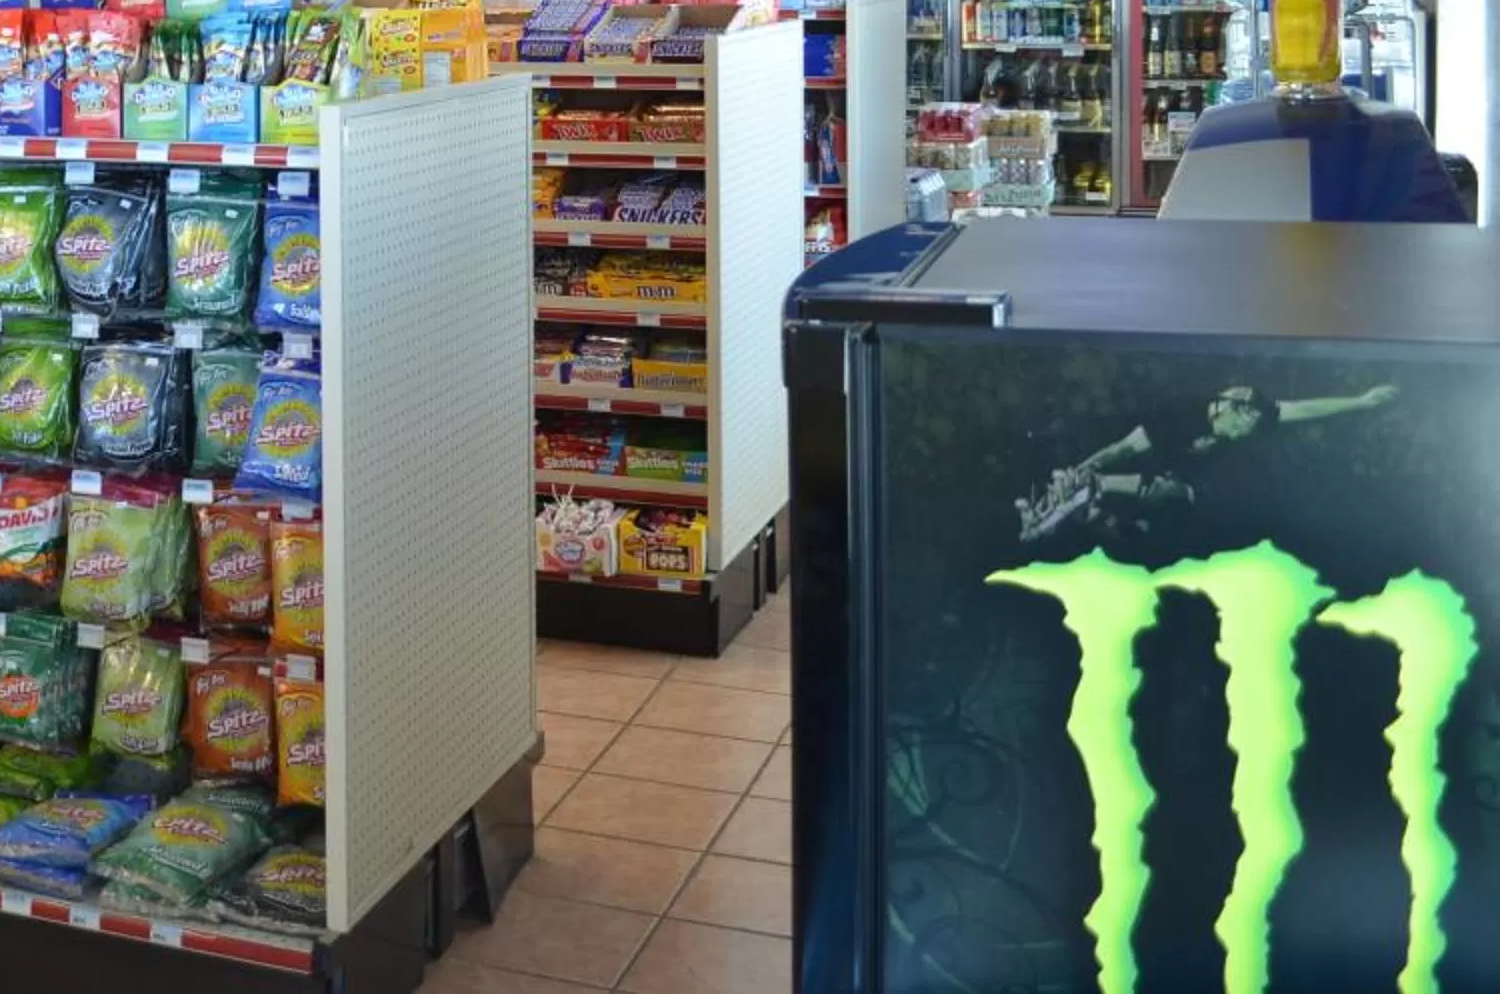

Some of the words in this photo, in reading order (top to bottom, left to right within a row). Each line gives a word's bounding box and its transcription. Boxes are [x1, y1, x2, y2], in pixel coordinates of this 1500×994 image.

[618, 207, 702, 225] SNICKERS
[208, 709, 268, 739] Spitz
[288, 737, 325, 765] Spi
